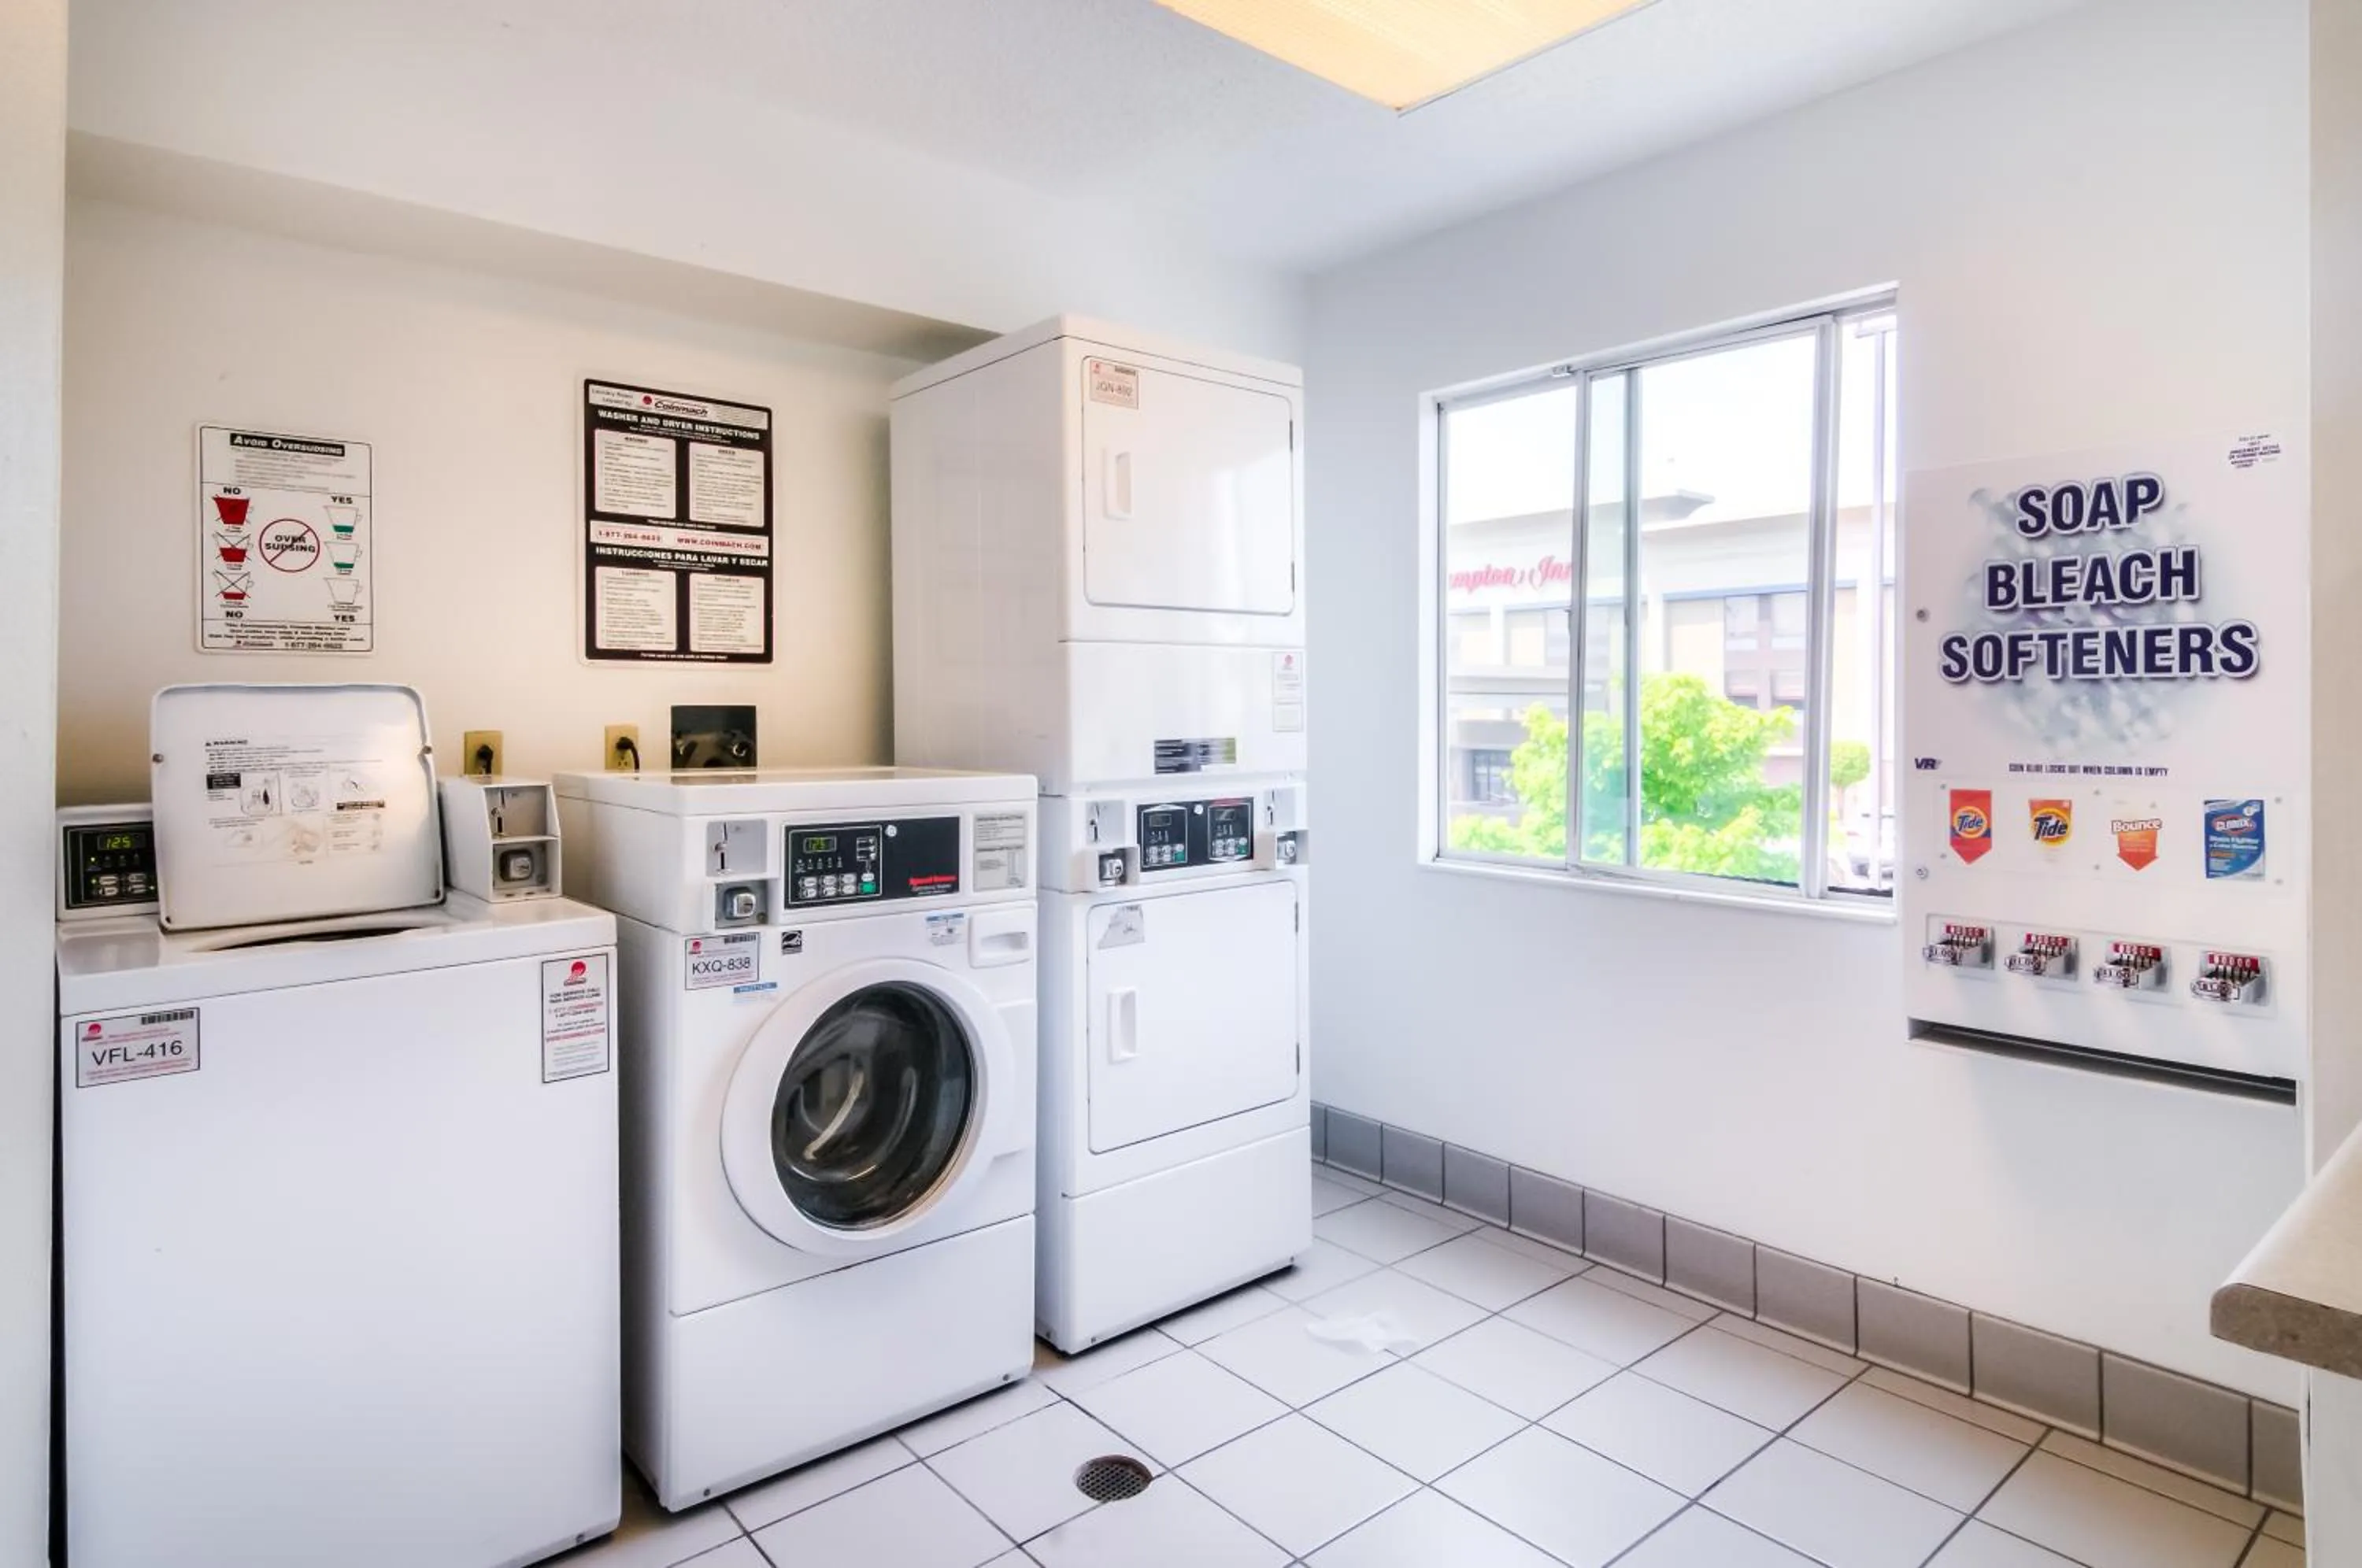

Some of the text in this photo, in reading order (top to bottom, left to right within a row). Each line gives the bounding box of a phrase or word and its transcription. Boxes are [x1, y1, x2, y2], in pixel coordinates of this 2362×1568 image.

[598, 409, 639, 423] WASHER
[641, 416, 660, 426] AND
[663, 419, 694, 430] DRYER
[695, 423, 760, 440] INSTRUCTIONS
[223, 486, 241, 495] NO
[331, 496, 353, 505] YES
[2017, 475, 2162, 535] SOAP
[275, 534, 306, 544] OVER
[596, 545, 672, 560] INSTRUCCIONES
[675, 553, 698, 561] PARA
[701, 554, 729, 564] LAVAR
[731, 557, 738, 565] Y
[1987, 548, 2197, 608] BLEACH
[1941, 623, 2256, 679] SOFTENERS
[2082, 765, 2101, 775] WHEN
[2104, 766, 2133, 775] COLUMN
[2134, 767, 2142, 775] IS
[2145, 767, 2169, 777] EMPTY
[1957, 814, 1983, 832] Tide
[2034, 815, 2068, 841] Tide
[2112, 819, 2162, 833] Bounce
[106, 836, 131, 850] 125
[692, 956, 751, 975] KXQ-838
[92, 1040, 183, 1066] VFL-416
